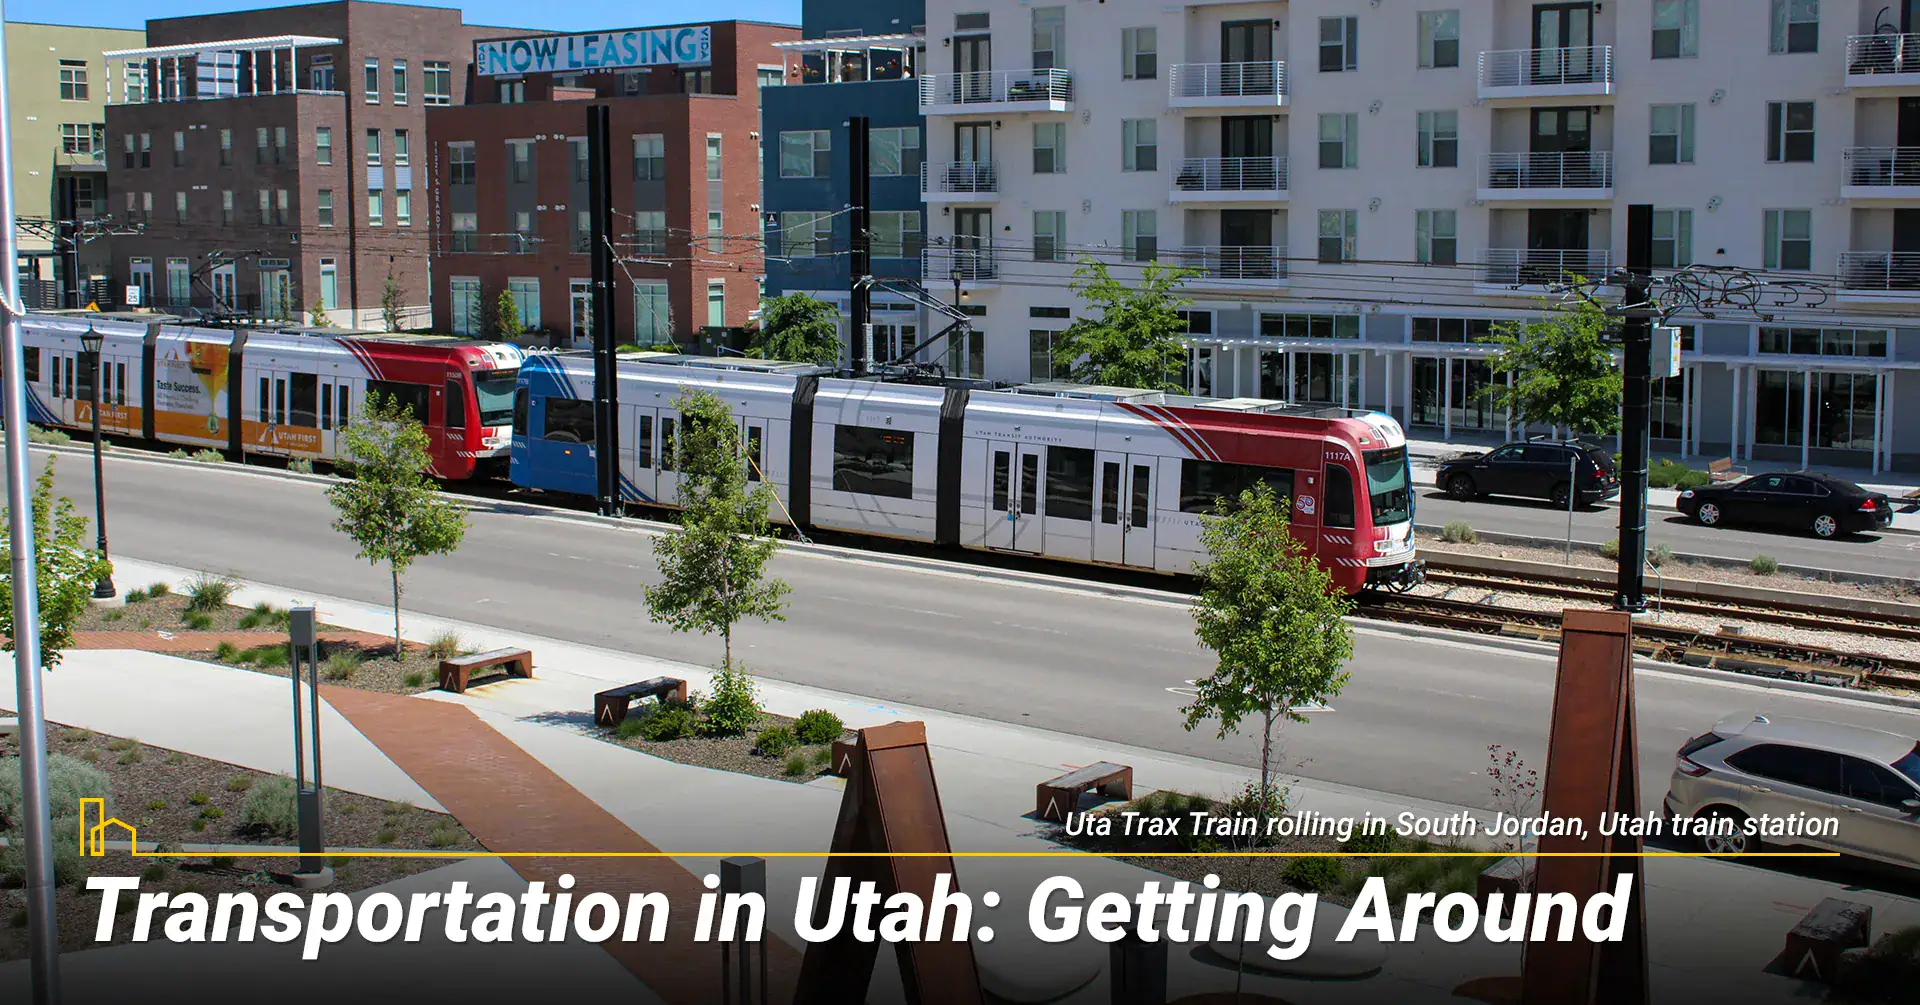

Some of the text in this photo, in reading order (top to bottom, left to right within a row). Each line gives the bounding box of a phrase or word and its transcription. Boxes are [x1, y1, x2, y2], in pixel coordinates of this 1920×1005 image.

[700, 27, 710, 60] VIDA
[488, 28, 697, 74] NOW LEASING
[478, 44, 486, 74] VIDA
[127, 294, 139, 303] 25
[156, 379, 201, 394] Taste Success.
[278, 431, 317, 443] UTAH FIRST
[994, 431, 1021, 439] TRANSIT
[1024, 435, 1062, 443] AUTHORITY
[1325, 451, 1351, 461] 1117A
